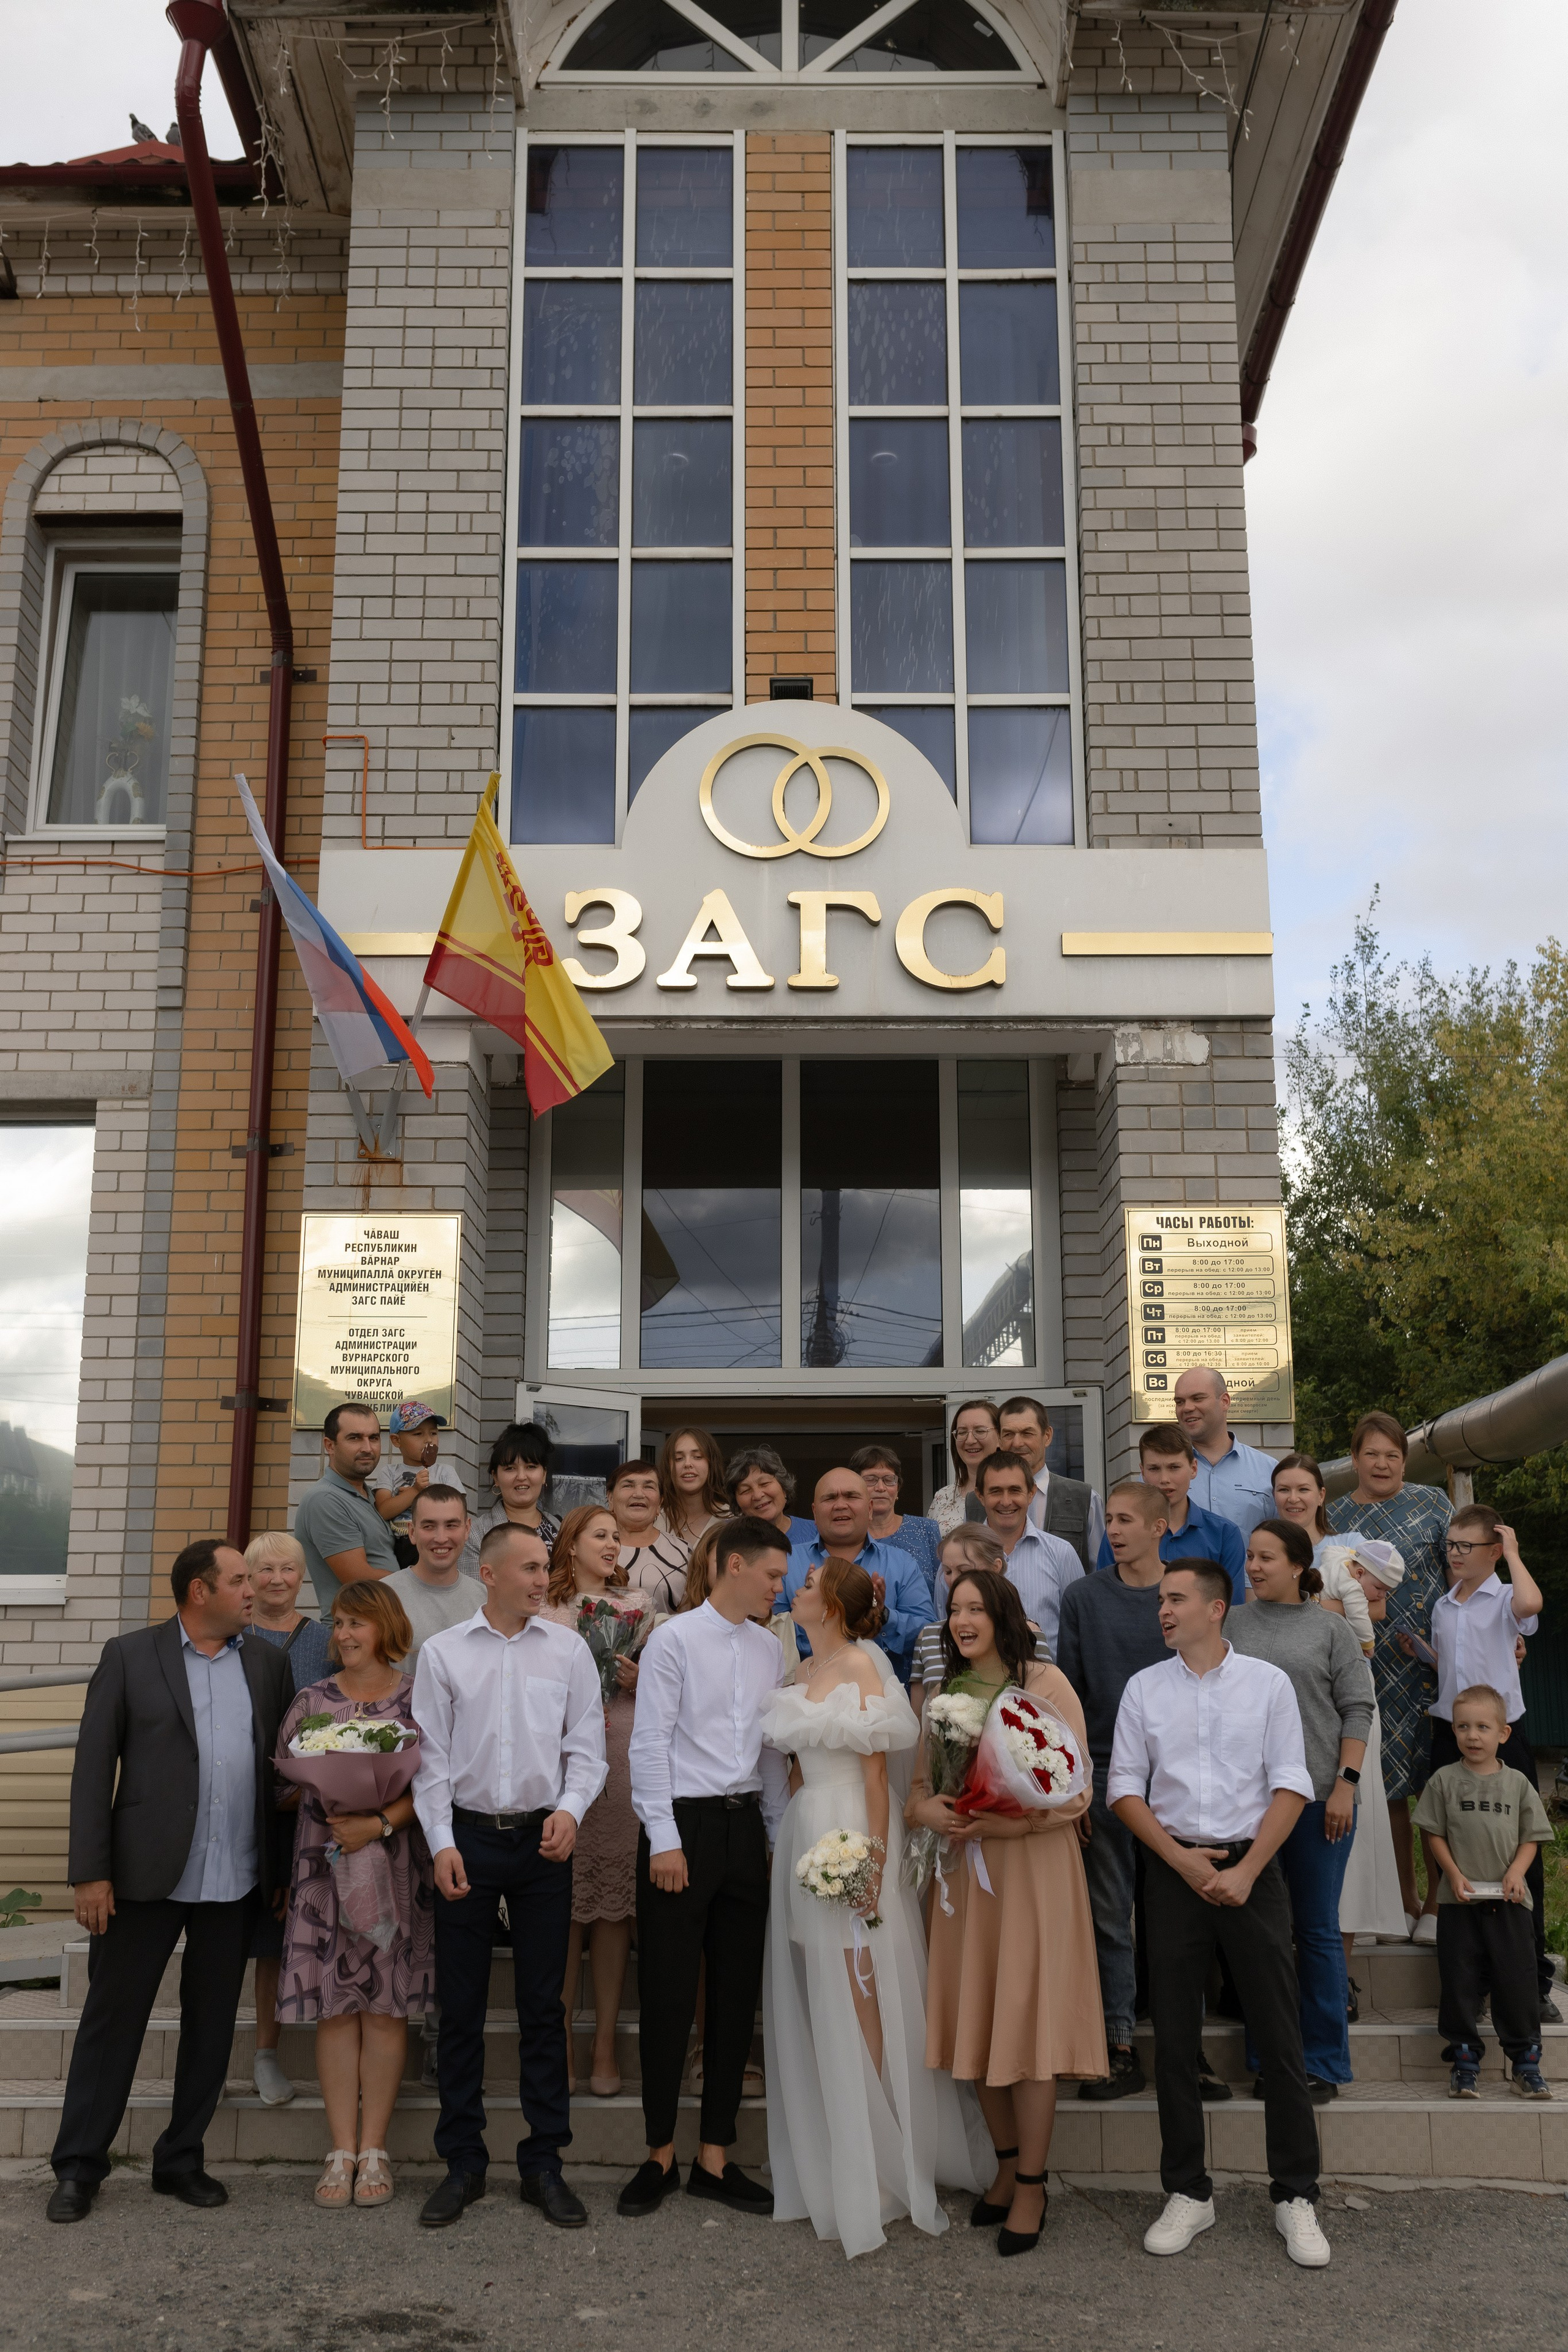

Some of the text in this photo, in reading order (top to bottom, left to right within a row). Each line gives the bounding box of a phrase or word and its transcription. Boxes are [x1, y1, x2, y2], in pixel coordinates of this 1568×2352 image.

[562, 887, 1006, 992] ЗАГС
[1156, 1216, 1254, 1229] ЧАСЫ РАБОТЫ:
[345, 1243, 417, 1253] РЕСПУБЛИКИН
[1144, 1238, 1160, 1248] Пн
[1188, 1238, 1248, 1248] Выходной
[1145, 1262, 1160, 1271] Вт
[1145, 1283, 1162, 1295] Ср
[352, 1296, 376, 1305] ЗАГС
[1147, 1307, 1162, 1317] Чт
[349, 1329, 405, 1338] ОТДЕЛ ЗАГС
[1147, 1331, 1163, 1341] Пт
[335, 1341, 417, 1351] АДМИНИСТРАЦИИ
[342, 1354, 409, 1362] ВУРНАРСКОГО
[1147, 1354, 1164, 1364] Сб
[331, 1366, 420, 1376] МУНИЦИПАЛЬНОГО
[357, 1378, 392, 1387] ОКРУГА
[1149, 1378, 1165, 1387] Вс
[1226, 1378, 1255, 1389] дной
[345, 1389, 404, 1400] ЧУВАШСКОЙ
[1460, 1800, 1511, 1815] BEST
